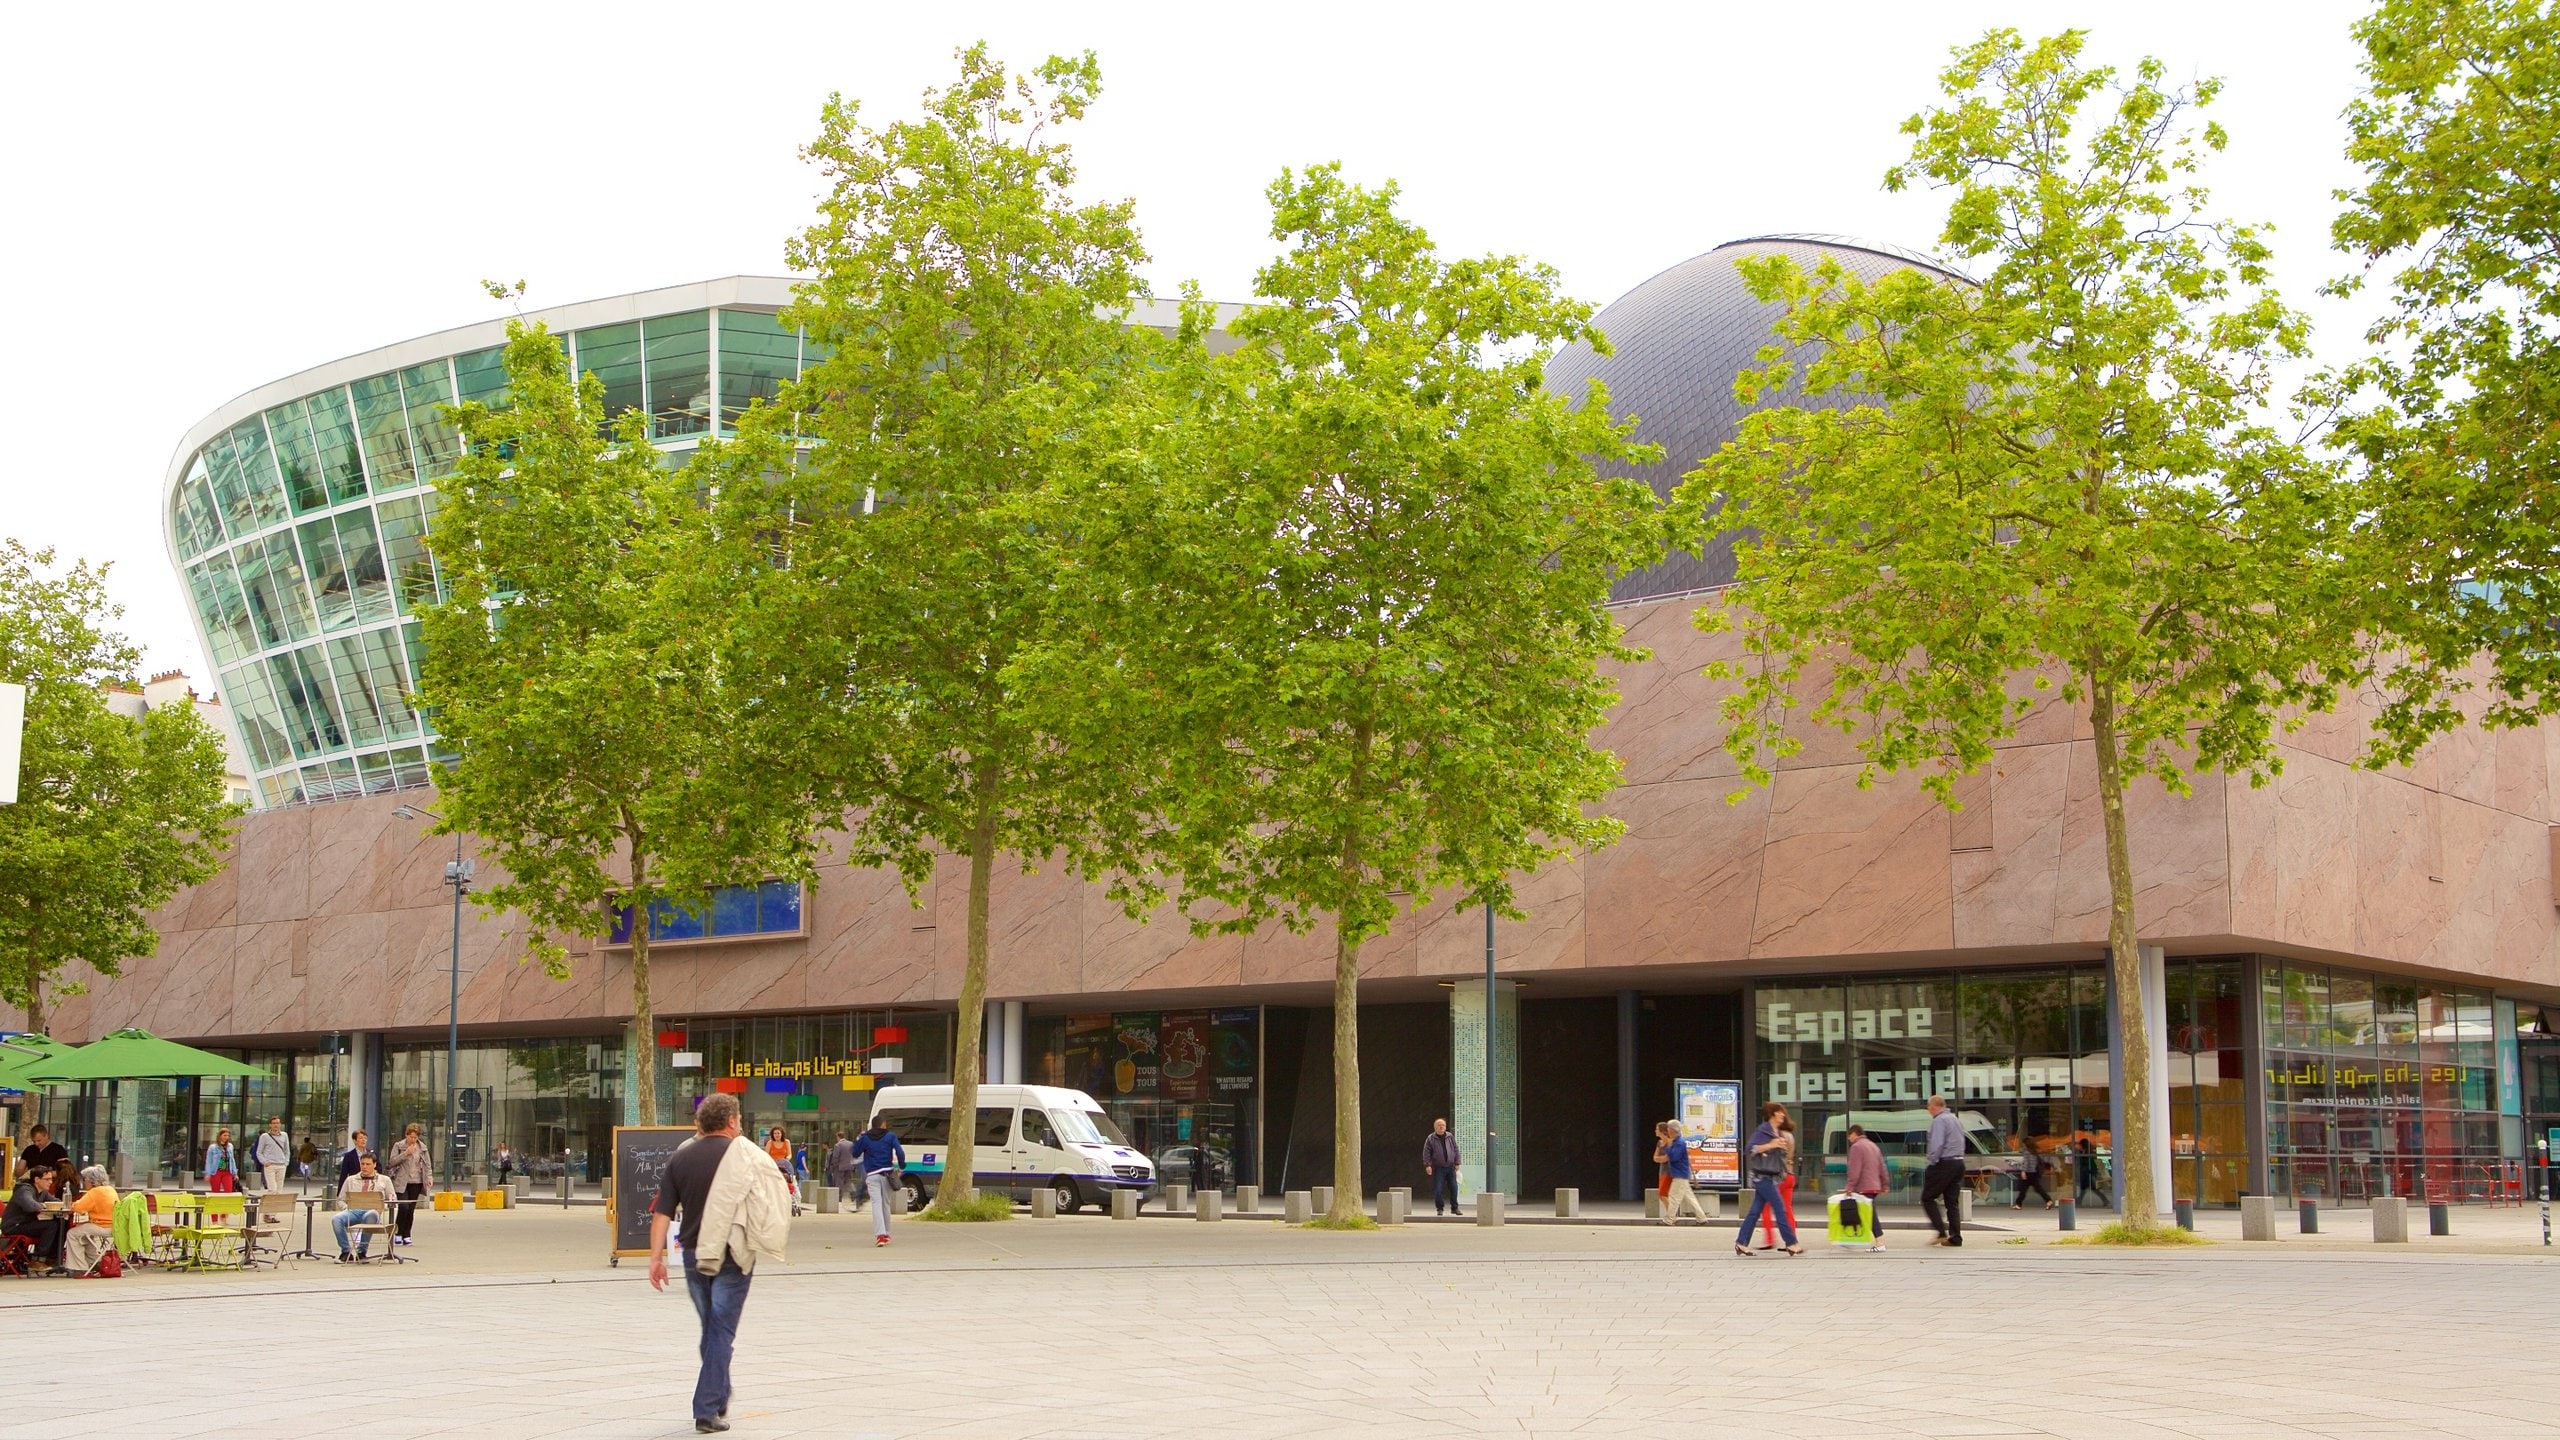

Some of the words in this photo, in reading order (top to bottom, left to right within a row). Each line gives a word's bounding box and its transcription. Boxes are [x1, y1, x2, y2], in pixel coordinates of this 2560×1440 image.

[1768, 1003, 1932, 1055] Espace
[753, 1058, 811, 1080] champs
[1136, 1066, 1157, 1075] TOUS
[1769, 1061, 1846, 1102] des
[1868, 1057, 2071, 1101] sciences
[1136, 1078, 1157, 1087] TOUS
